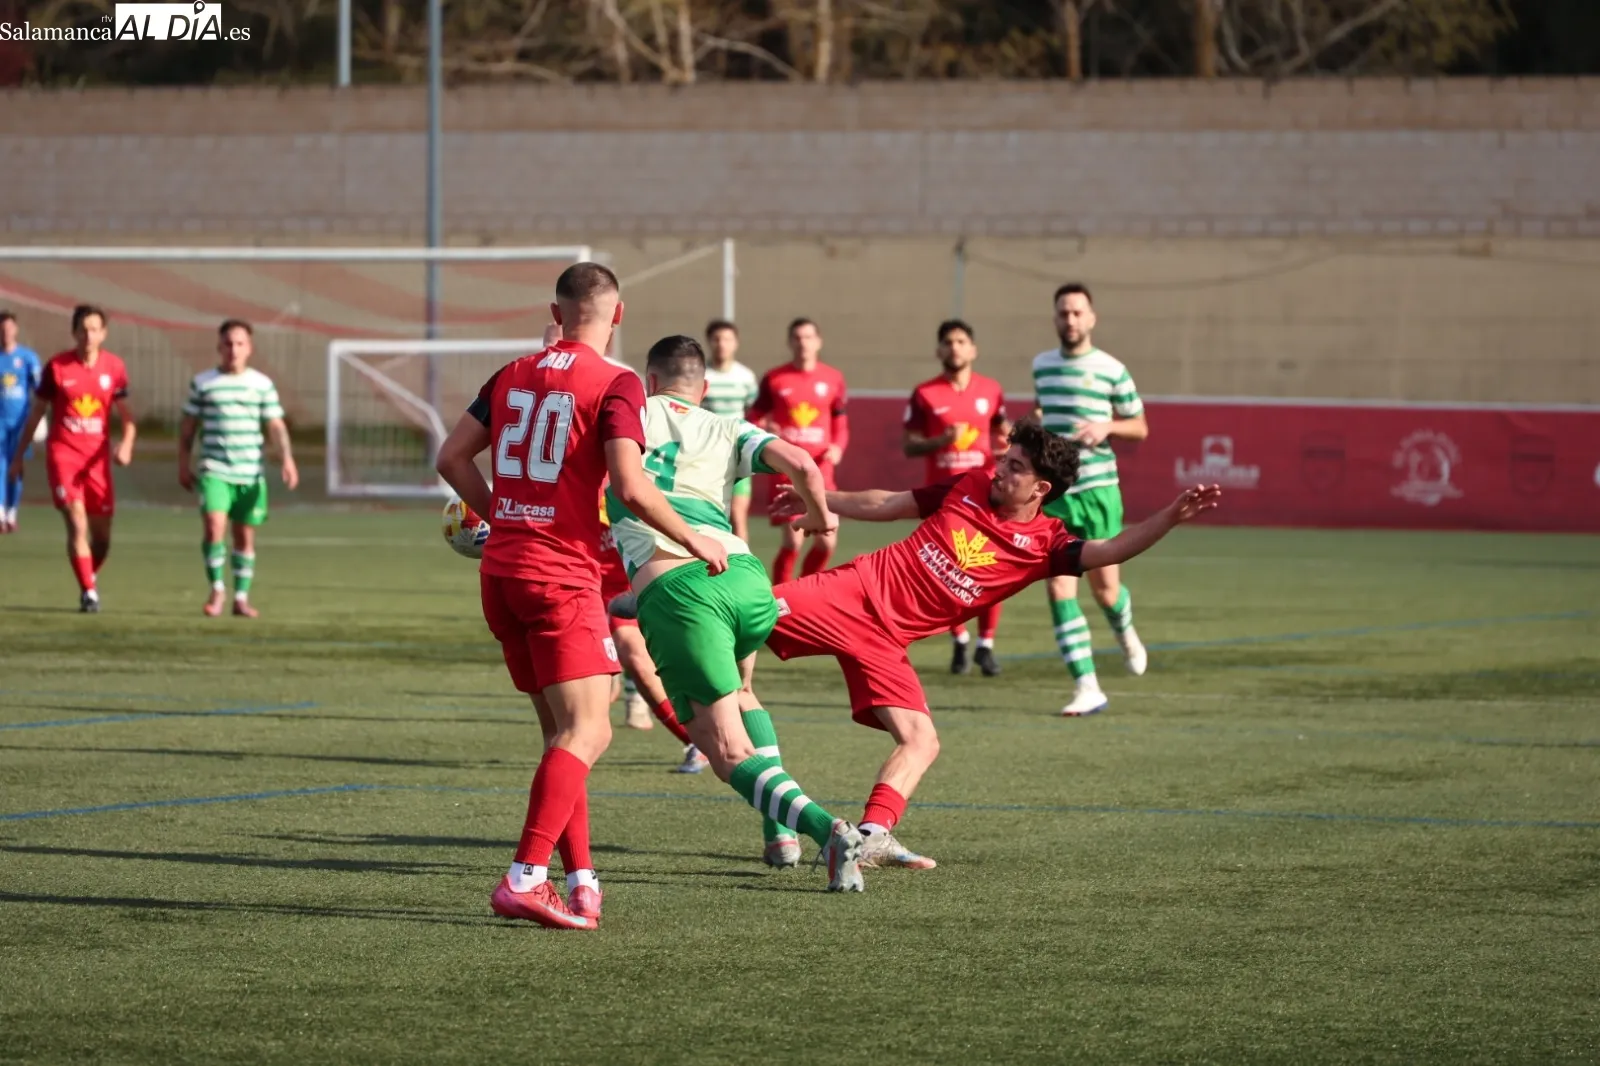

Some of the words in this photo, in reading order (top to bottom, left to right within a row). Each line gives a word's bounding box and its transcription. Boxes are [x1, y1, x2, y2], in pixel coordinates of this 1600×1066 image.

[496, 388, 575, 484] 20
[644, 441, 681, 493] 4
[926, 559, 975, 606] SALAMANCA
[947, 564, 984, 598] RURAL
